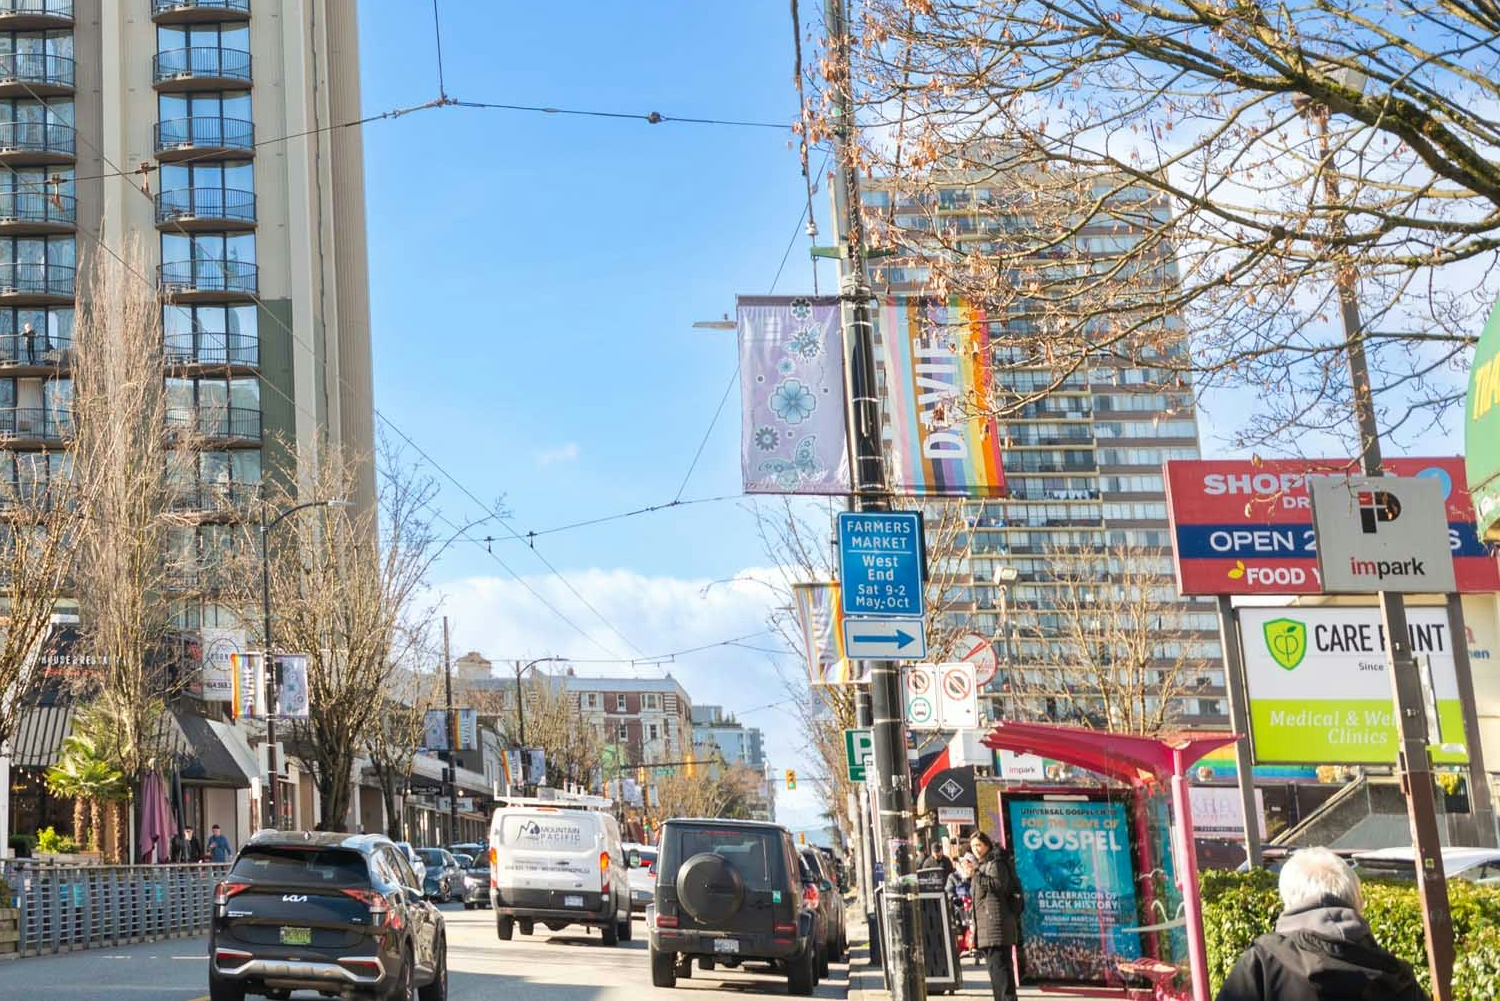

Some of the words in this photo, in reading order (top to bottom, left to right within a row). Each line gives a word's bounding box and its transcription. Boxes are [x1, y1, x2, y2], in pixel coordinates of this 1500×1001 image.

[1283, 496, 1311, 509] DR
[847, 521, 910, 534] FARMERS
[851, 537, 907, 549] MARKET
[1209, 531, 1295, 551] OPEN
[862, 555, 899, 568] West
[1350, 556, 1426, 580] impark
[867, 569, 894, 581] End
[1246, 567, 1306, 585] FOOD
[858, 584, 879, 595] Sat
[885, 584, 906, 595] 9-2
[1314, 624, 1374, 652] CARE
[1358, 661, 1385, 672] Since
[1269, 710, 1339, 727] Medical
[1345, 710, 1360, 727] &
[1327, 727, 1389, 744] Clinics
[1009, 767, 1036, 775] impark
[1021, 808, 1063, 816] UNIVERSAL
[1021, 818, 1044, 827] FOR
[541, 826, 580, 834] MOUNTAIN
[1022, 829, 1122, 851] GOSPEL
[1037, 891, 1043, 899] A
[1045, 891, 1103, 899] CELEBRATION
[1039, 900, 1072, 909] BLACK
[1074, 901, 1118, 910] HISTORY
